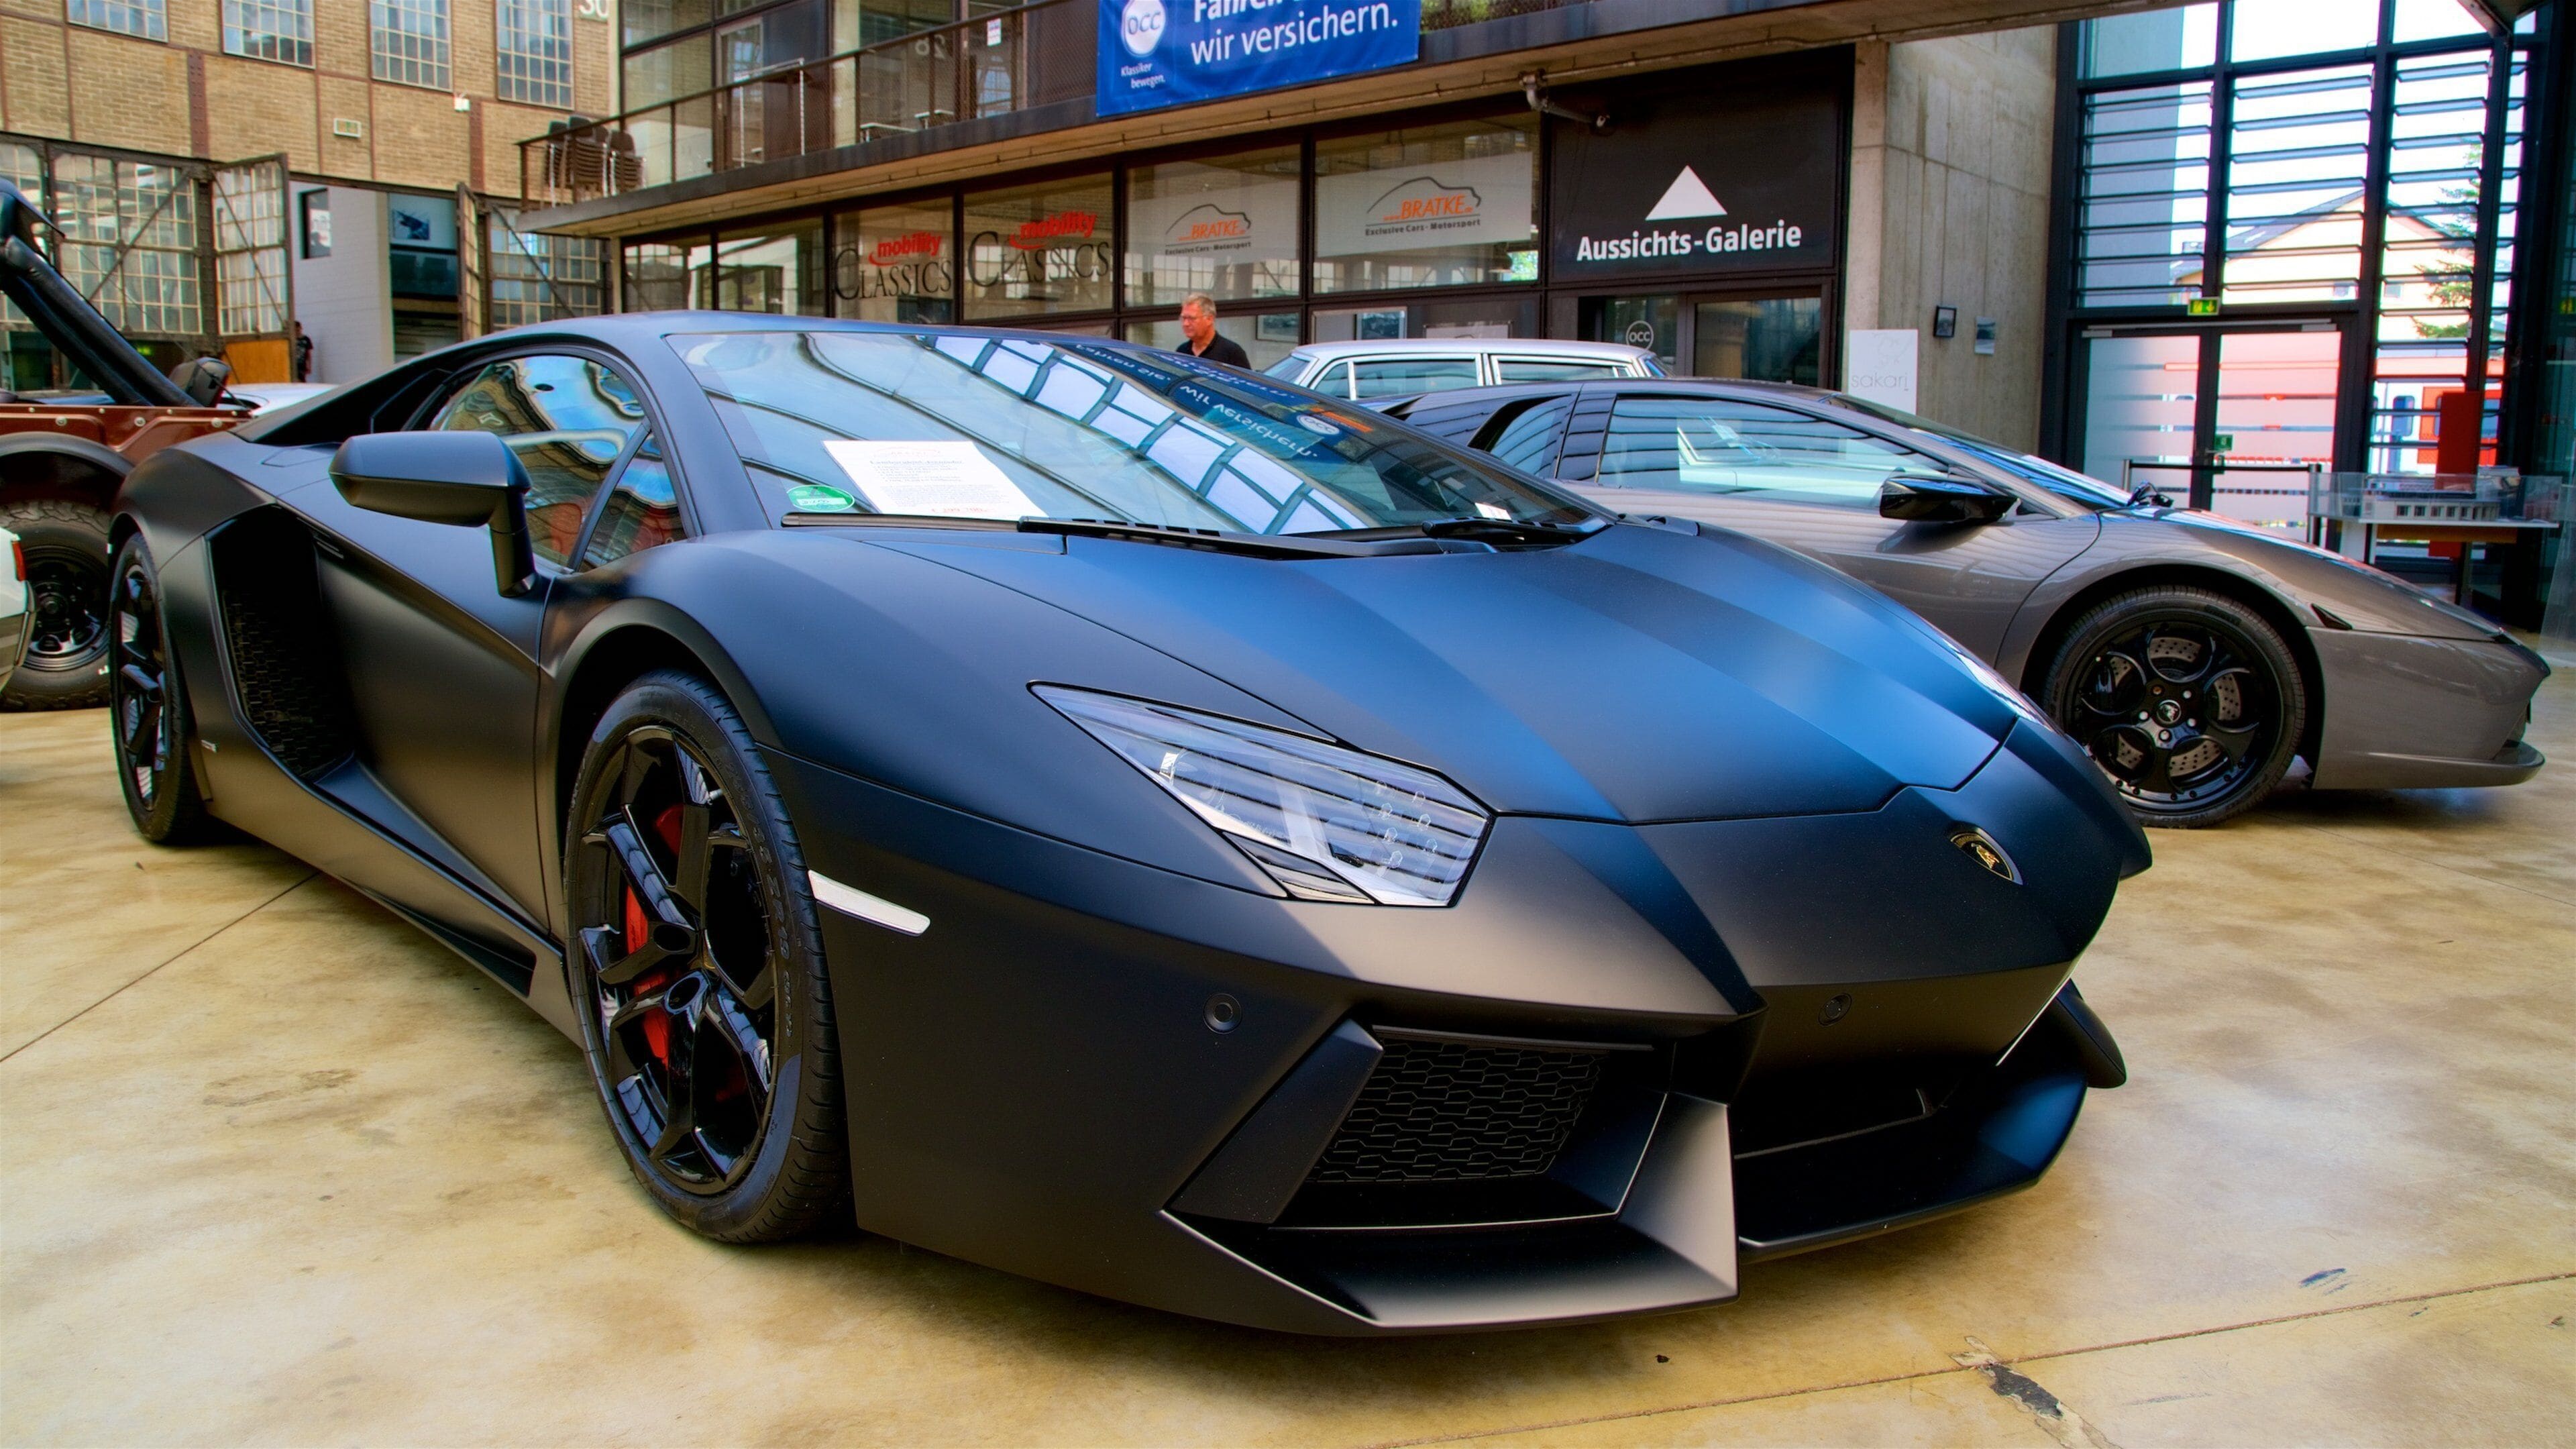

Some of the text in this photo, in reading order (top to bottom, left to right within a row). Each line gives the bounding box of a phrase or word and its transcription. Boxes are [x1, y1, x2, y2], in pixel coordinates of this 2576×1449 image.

[1194, 0, 1283, 23] Fahr
[1191, 3, 1399, 65] wir versichern.
[1121, 62, 1152, 76] Klassiker
[1020, 211, 1098, 240] mobility
[1365, 225, 1406, 236] Exclusive
[1406, 223, 1424, 233] Cars
[1430, 219, 1481, 231] Motorsport
[877, 231, 942, 258] mobility
[1577, 220, 1802, 262] Aussichts-Galerie
